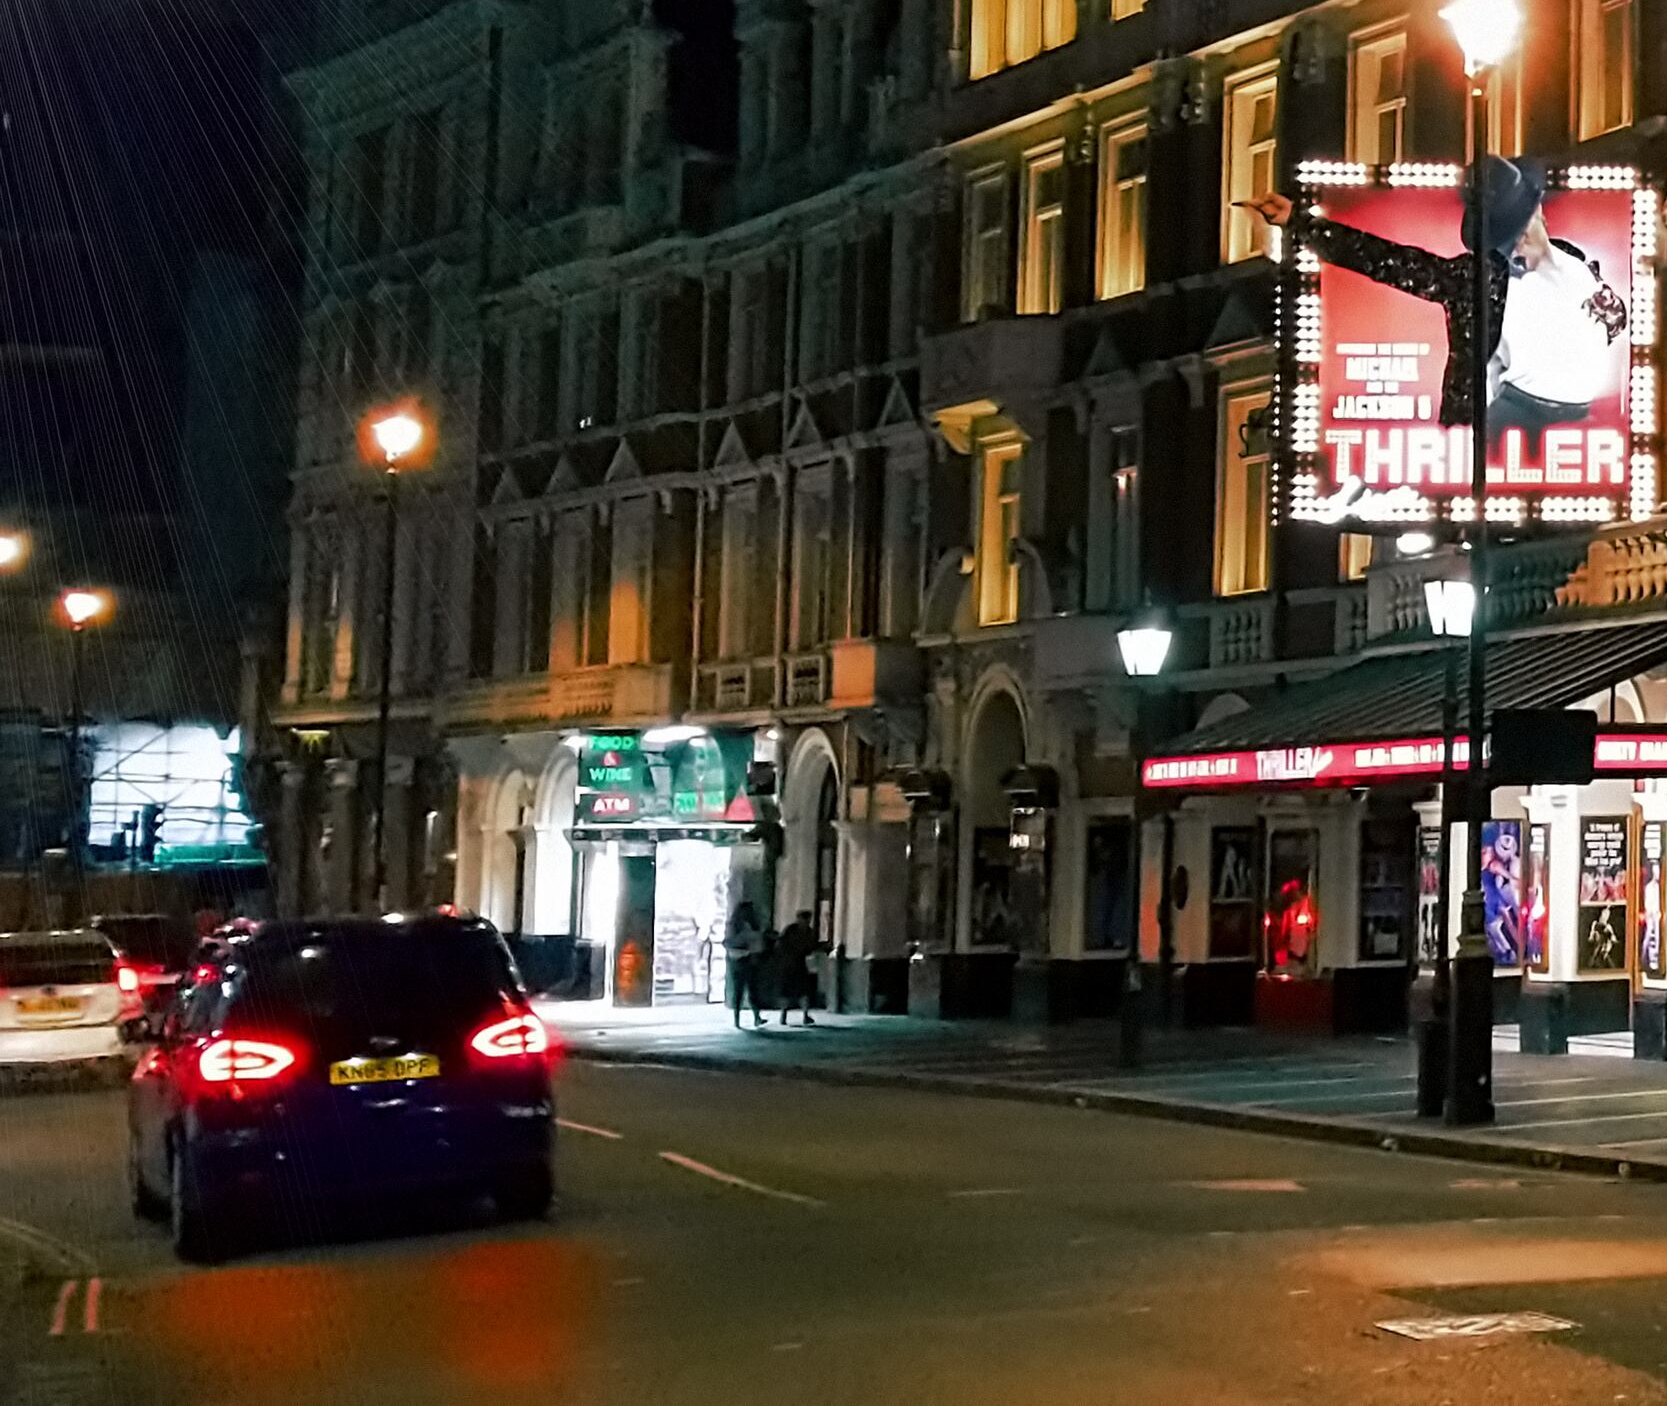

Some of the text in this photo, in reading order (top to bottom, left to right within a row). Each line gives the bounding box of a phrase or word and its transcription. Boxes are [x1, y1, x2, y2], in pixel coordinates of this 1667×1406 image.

[588, 735, 635, 751] FOOD
[589, 767, 632, 782] WINE
[592, 798, 631, 813] ATM
